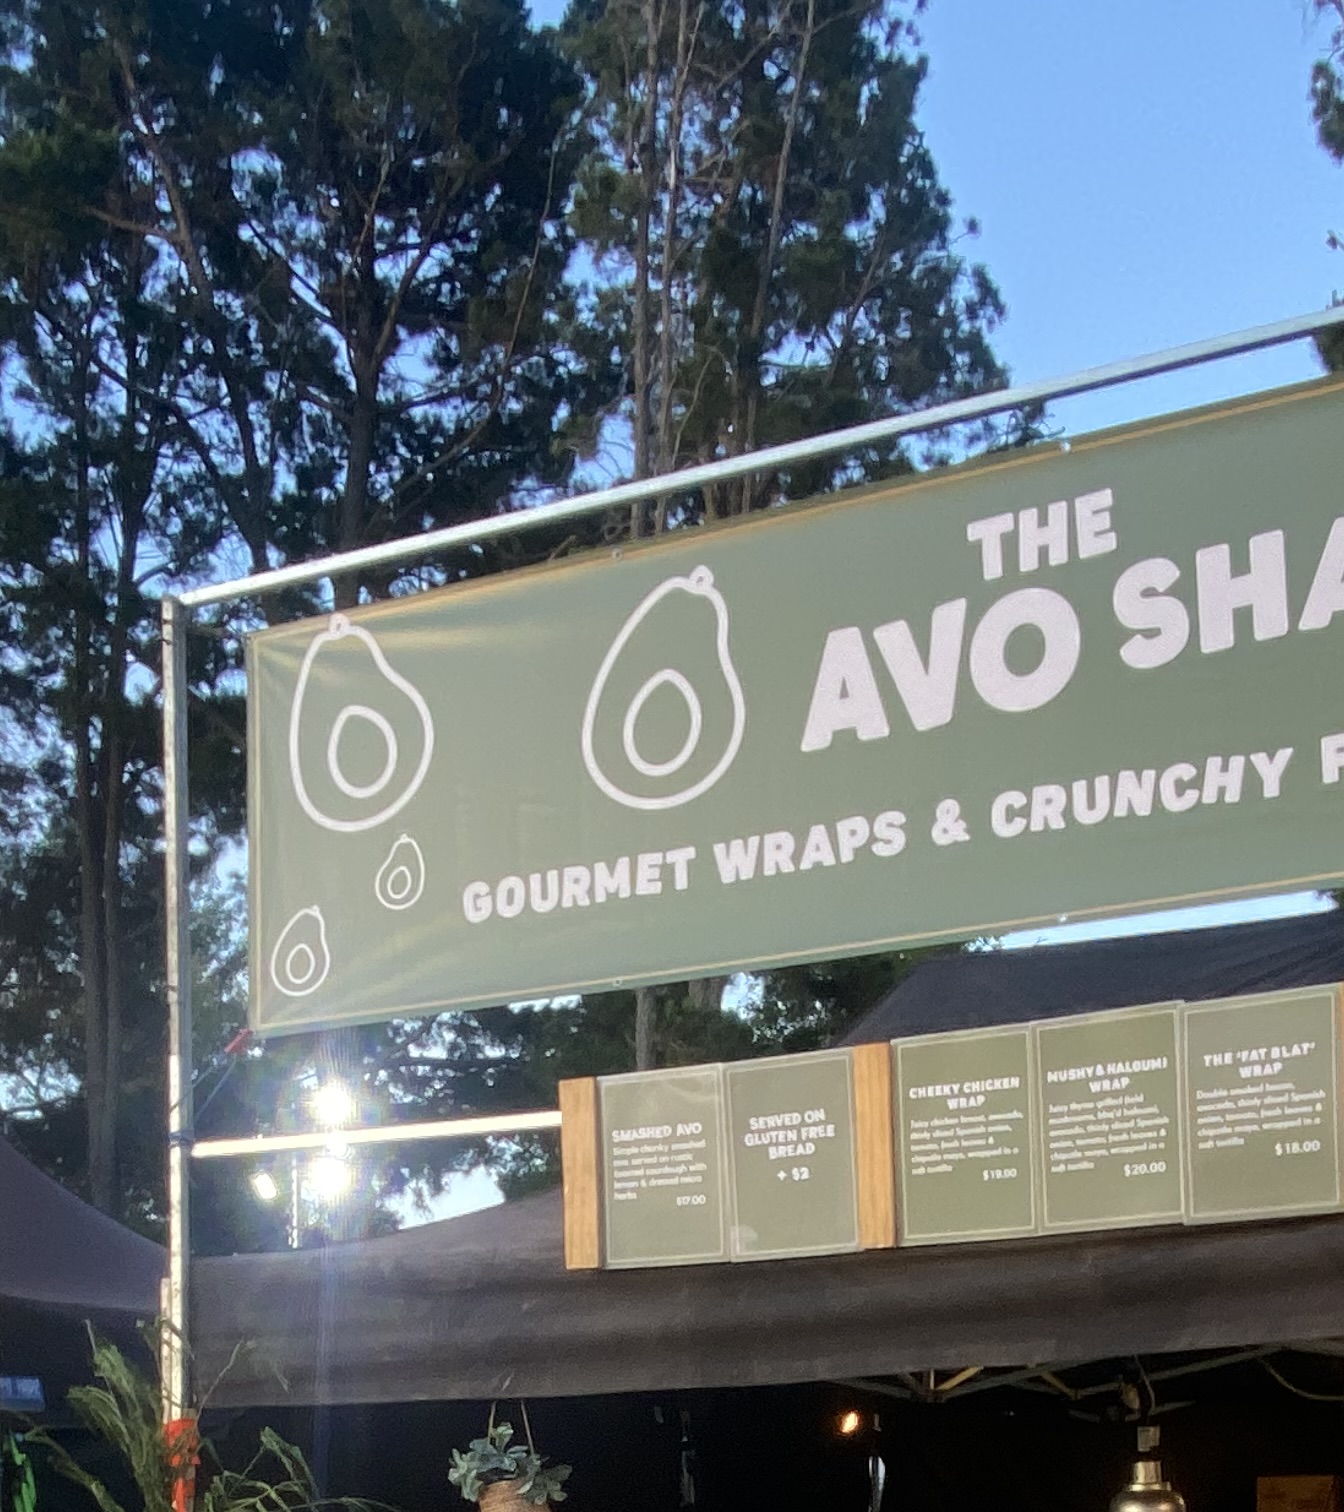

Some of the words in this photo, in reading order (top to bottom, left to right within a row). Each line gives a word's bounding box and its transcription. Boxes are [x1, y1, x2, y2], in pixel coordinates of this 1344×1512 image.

[965, 486, 1119, 583] THE
[798, 586, 1082, 754] AVO
[462, 843, 697, 924] GOURMET
[711, 809, 908, 885] WRAPS
[930, 797, 973, 848] &
[990, 746, 1294, 840] CRUNCHY
[1047, 1066, 1094, 1083] MUSHY
[1106, 1056, 1168, 1075] HALOUMI
[1203, 1052, 1233, 1067] THE
[1239, 1061, 1282, 1079] WRAP
[909, 1083, 961, 1099] CHEEKY
[962, 1076, 1020, 1093] CHICKEN
[1088, 1076, 1130, 1093] WRAP
[947, 1094, 986, 1110] WRAP
[749, 1112, 802, 1130] SERVED
[804, 1108, 826, 1124] ON
[611, 1125, 672, 1143] SMASHED
[676, 1121, 702, 1137] AVO
[744, 1129, 798, 1147] GLUTEN
[801, 1124, 836, 1141] FREE
[768, 1142, 816, 1160] BREAD
[791, 1166, 810, 1181] $2
[1123, 1161, 1167, 1177] $20.00
